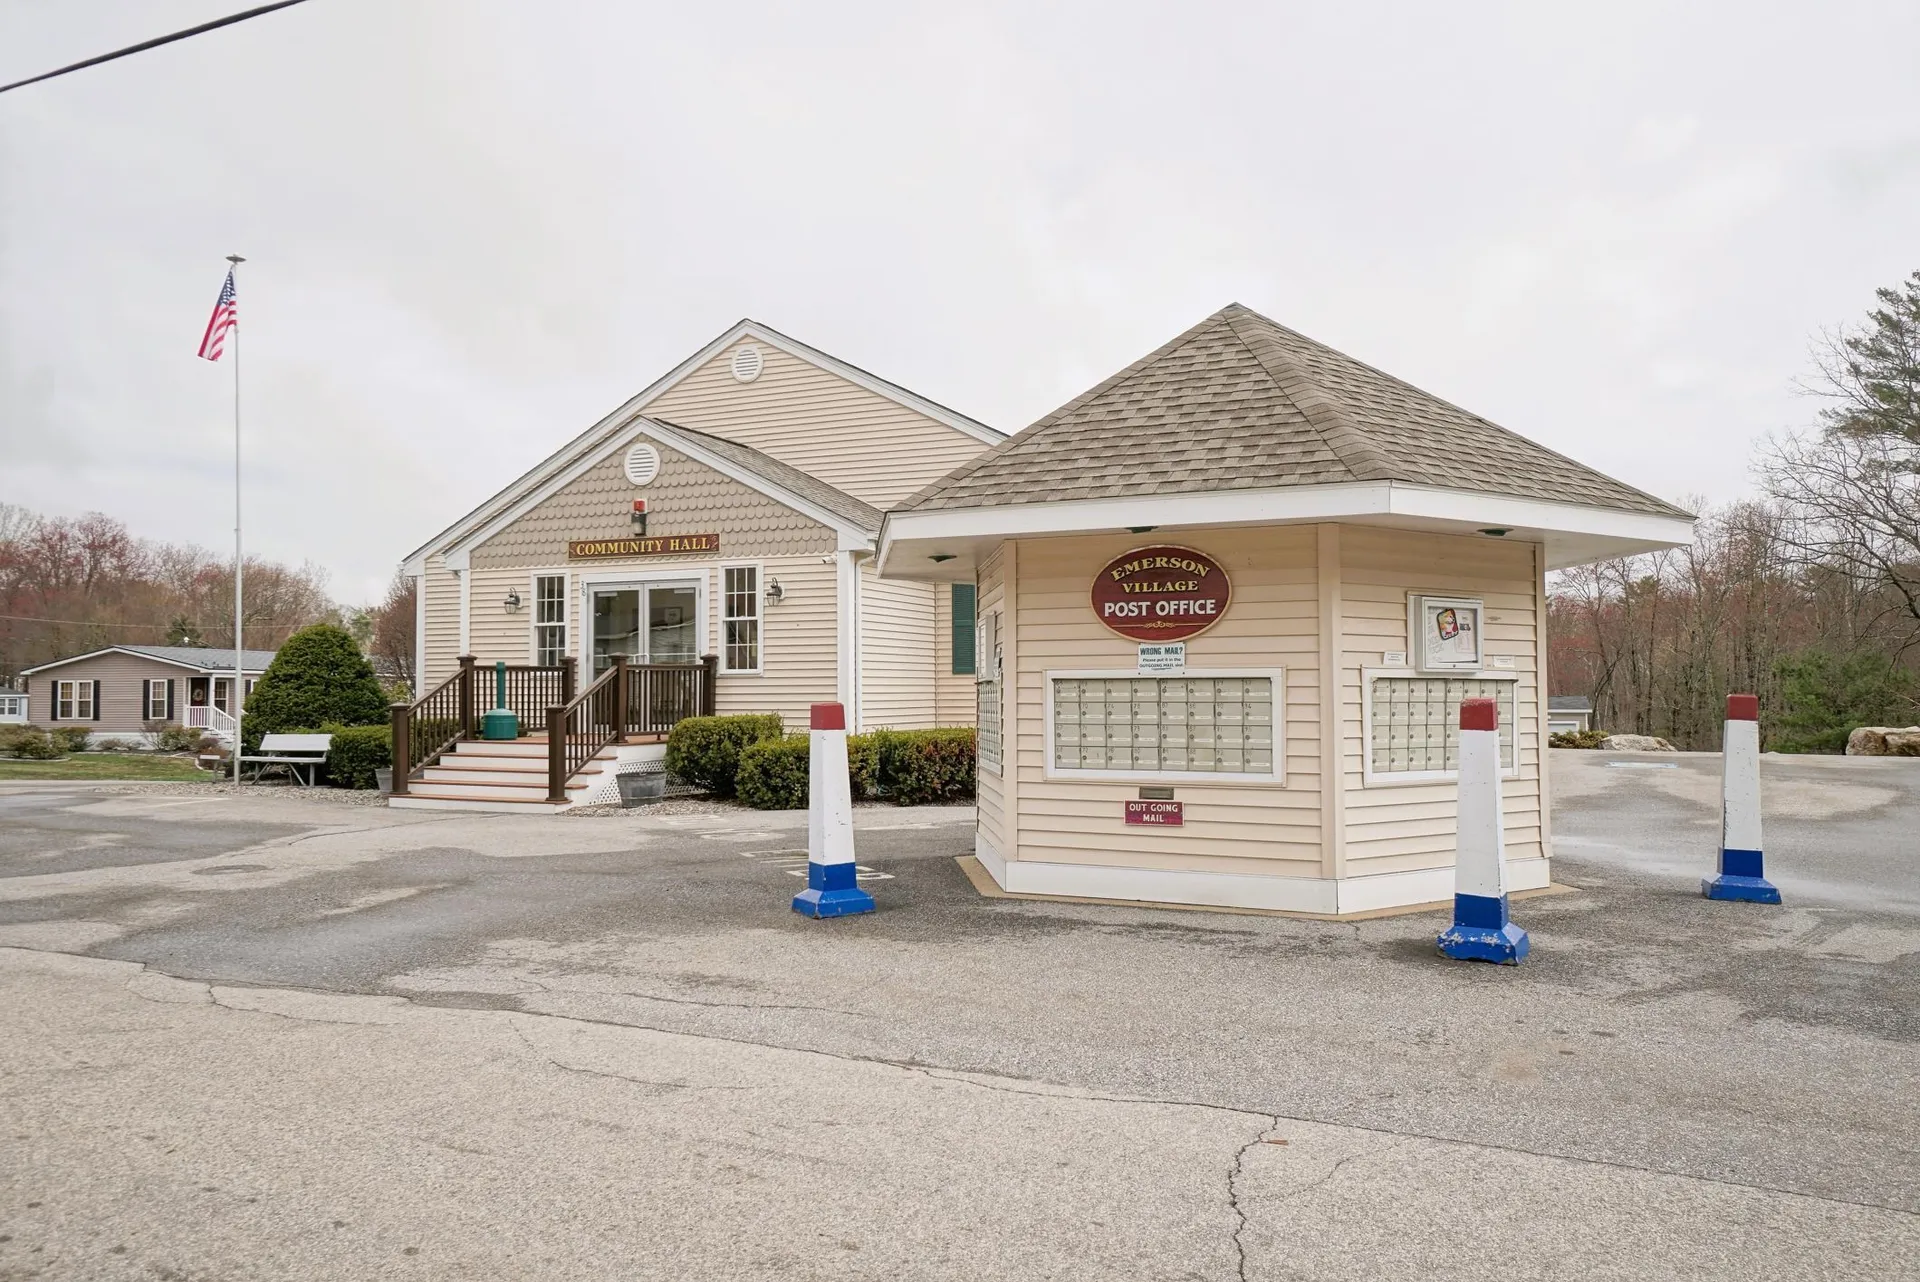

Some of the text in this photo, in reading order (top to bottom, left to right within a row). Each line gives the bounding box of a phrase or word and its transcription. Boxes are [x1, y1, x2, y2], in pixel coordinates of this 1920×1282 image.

[576, 537, 710, 556] COMMUNITY HALL
[1111, 557, 1210, 582] EMERSON
[1122, 580, 1199, 593] VILLAGE
[1104, 599, 1217, 618] POST OFFICE
[1140, 647, 1162, 656] WRONG
[1129, 803, 1178, 812] OUT GOING
[1142, 814, 1164, 822] MAIL
